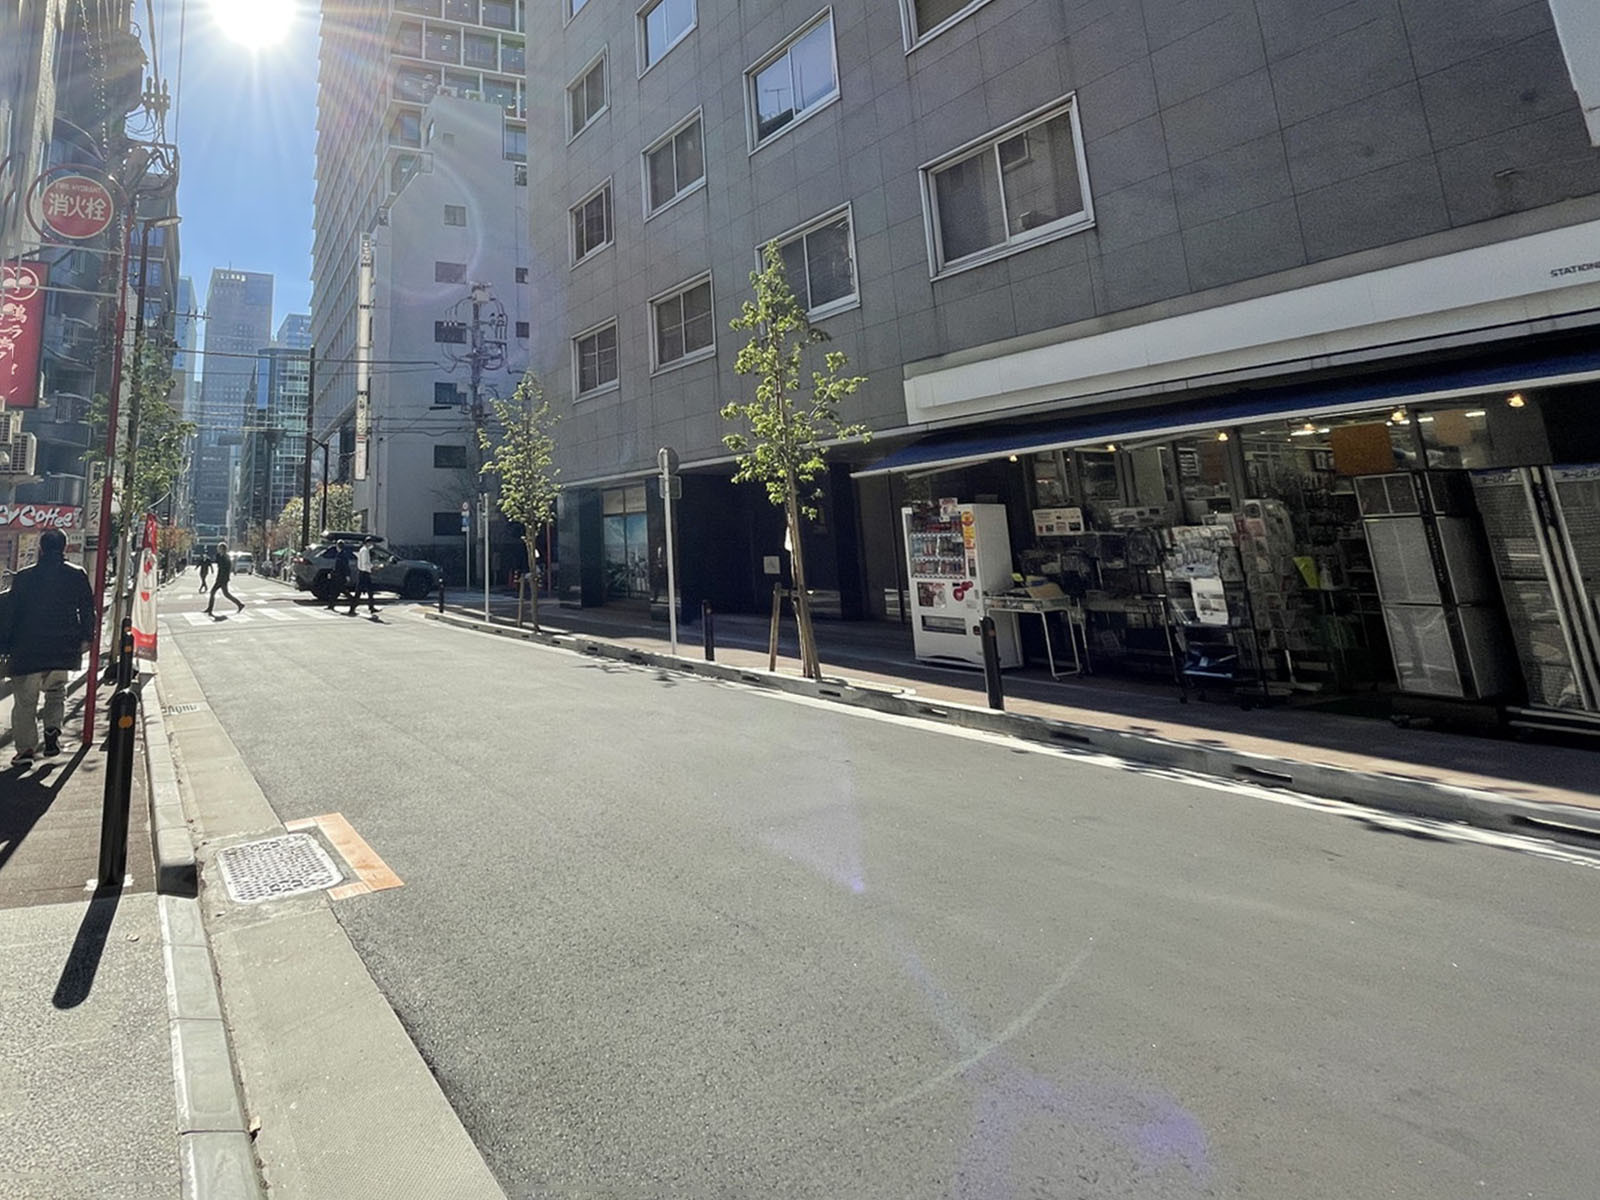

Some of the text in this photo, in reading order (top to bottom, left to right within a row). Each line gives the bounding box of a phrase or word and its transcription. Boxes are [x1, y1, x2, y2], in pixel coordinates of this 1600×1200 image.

[48, 192, 107, 221] 消火栓
[20, 504, 73, 528] Coffee
